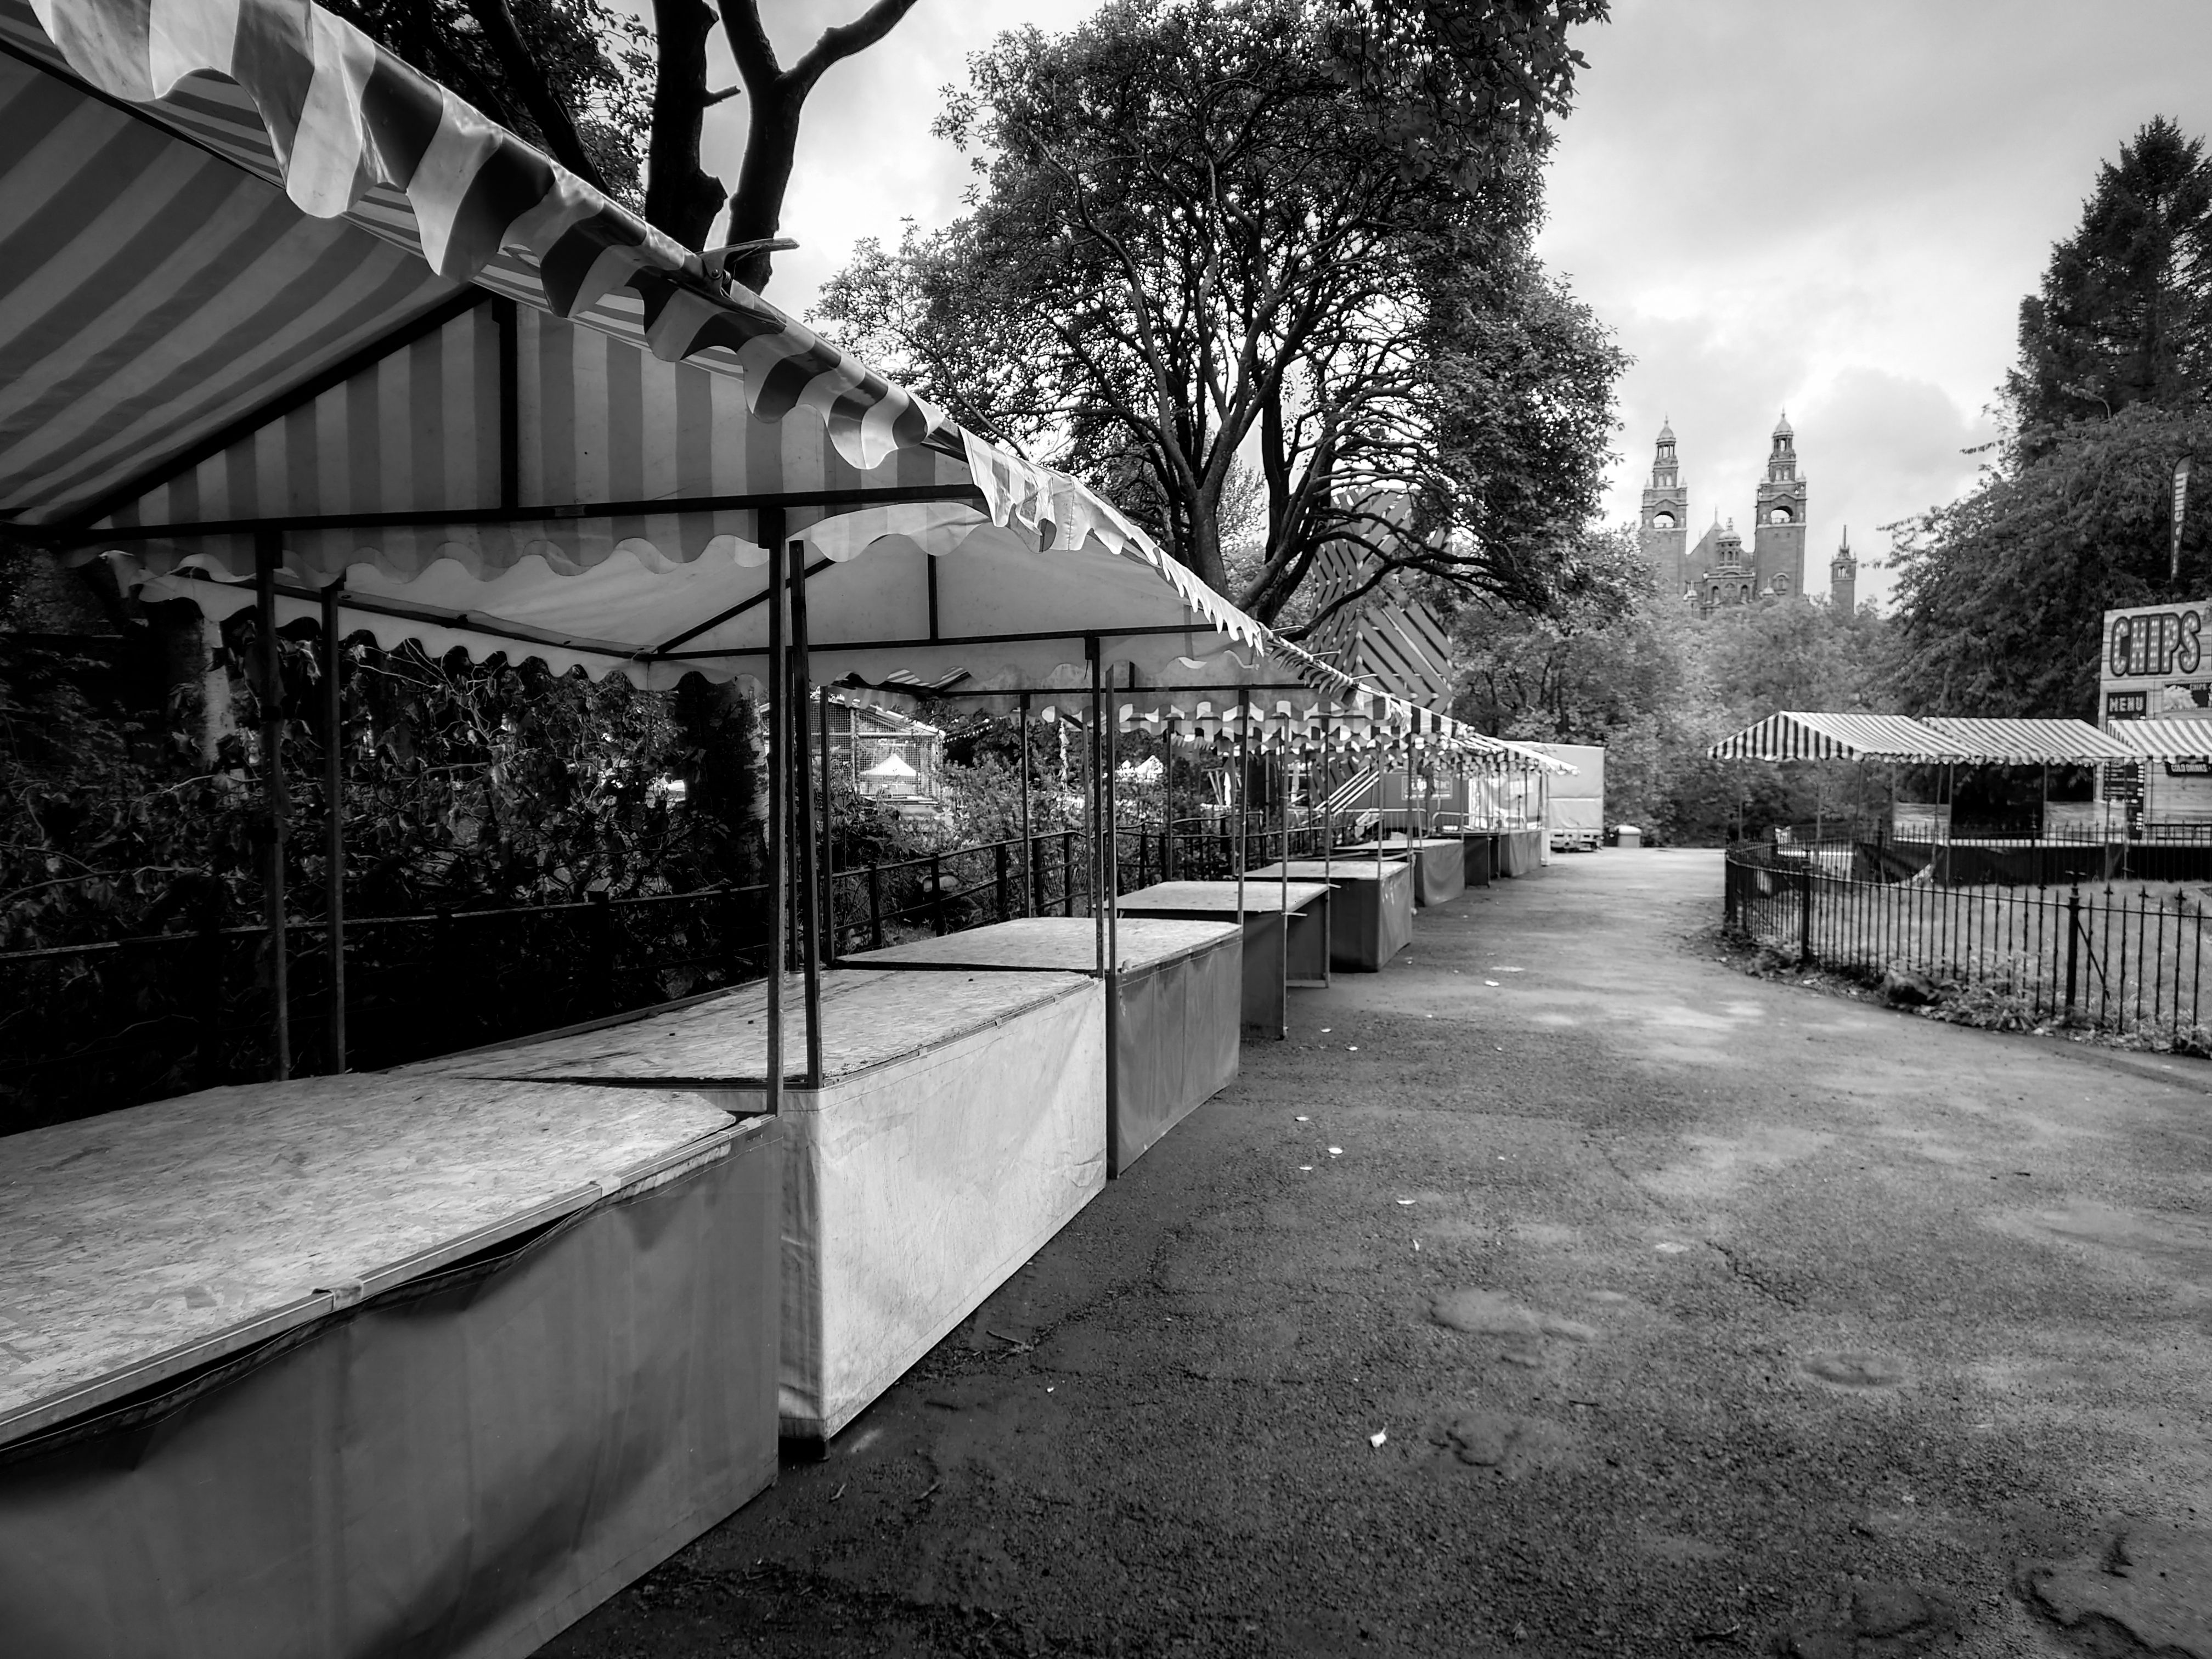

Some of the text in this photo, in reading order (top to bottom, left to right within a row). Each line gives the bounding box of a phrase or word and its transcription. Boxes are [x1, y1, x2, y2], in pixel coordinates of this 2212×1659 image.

[2175, 472, 2187, 522] CHILLI
[2110, 610, 2201, 677] CHIPS
[2109, 696, 2144, 712] MENU
